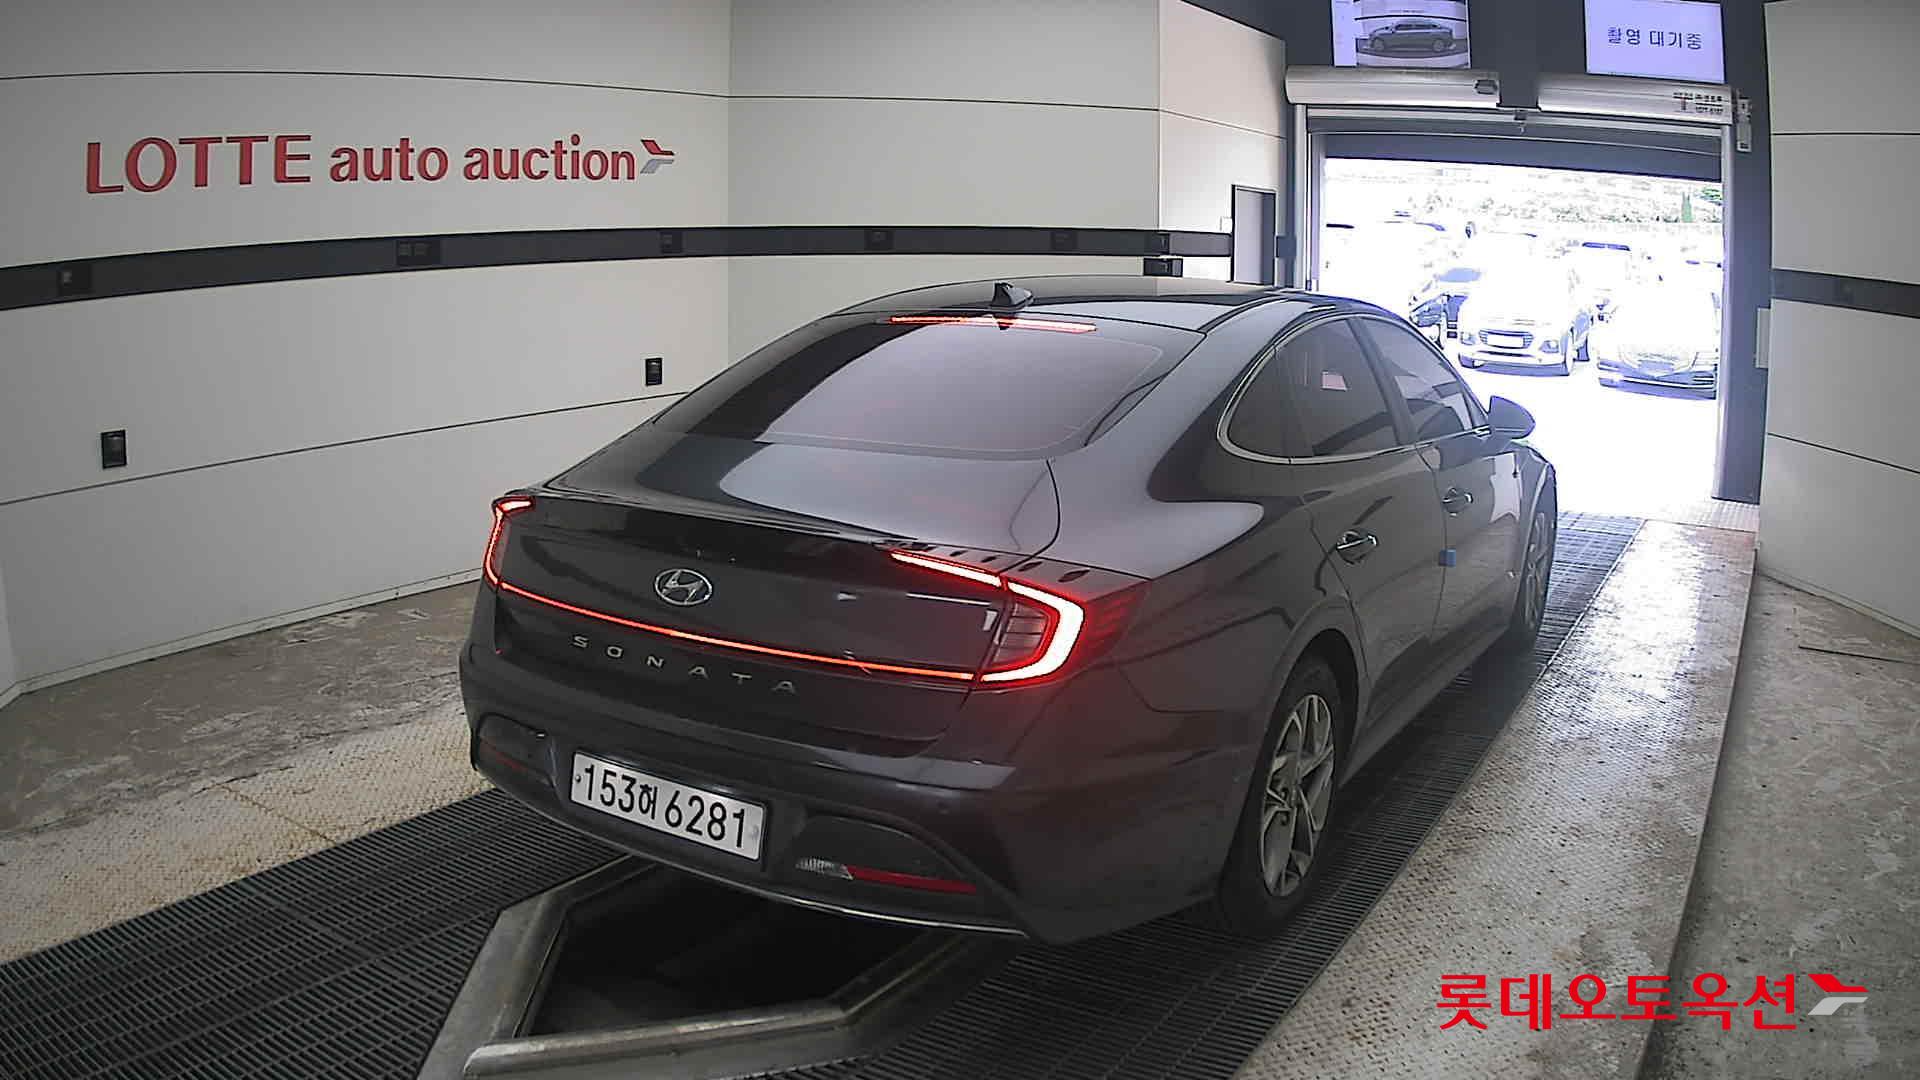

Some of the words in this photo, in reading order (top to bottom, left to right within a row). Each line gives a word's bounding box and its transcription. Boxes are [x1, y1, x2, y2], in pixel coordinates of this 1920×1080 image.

[1649, 30, 1702, 50] 대기중
[87, 134, 312, 193] LOTTE
[329, 136, 449, 183] auto
[464, 133, 637, 182] auction
[572, 635, 796, 695] SONATA
[664, 789, 746, 849] 6281
